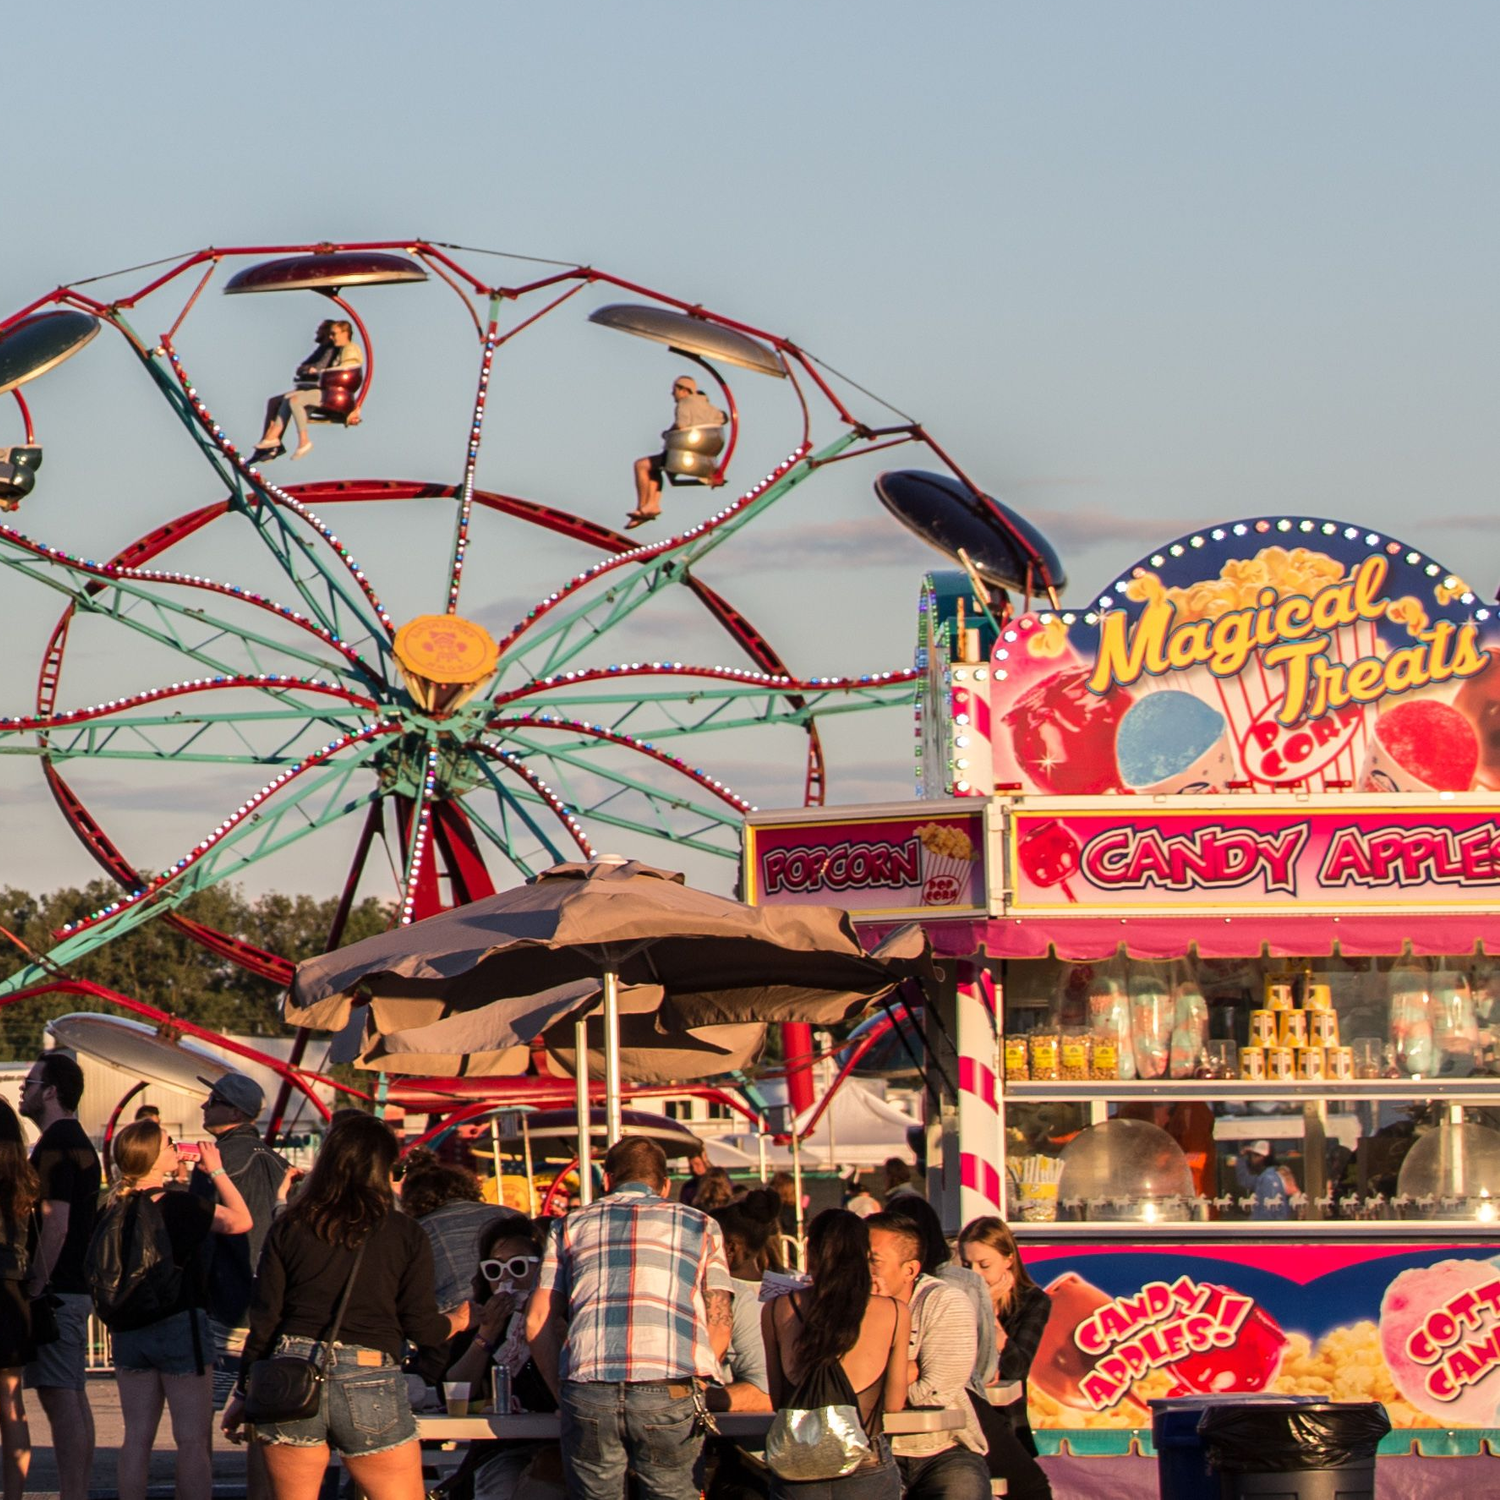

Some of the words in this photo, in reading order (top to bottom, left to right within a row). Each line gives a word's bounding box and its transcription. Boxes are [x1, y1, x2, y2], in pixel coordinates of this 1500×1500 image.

[1086, 553, 1392, 697] Magical
[1263, 619, 1491, 728] Treats
[762, 836, 922, 895] POPCORN
[1079, 820, 1312, 897] CANDY
[1317, 819, 1500, 888] APPLE
[1075, 1275, 1211, 1355] CANDY
[1078, 1296, 1254, 1410] APPLES!
